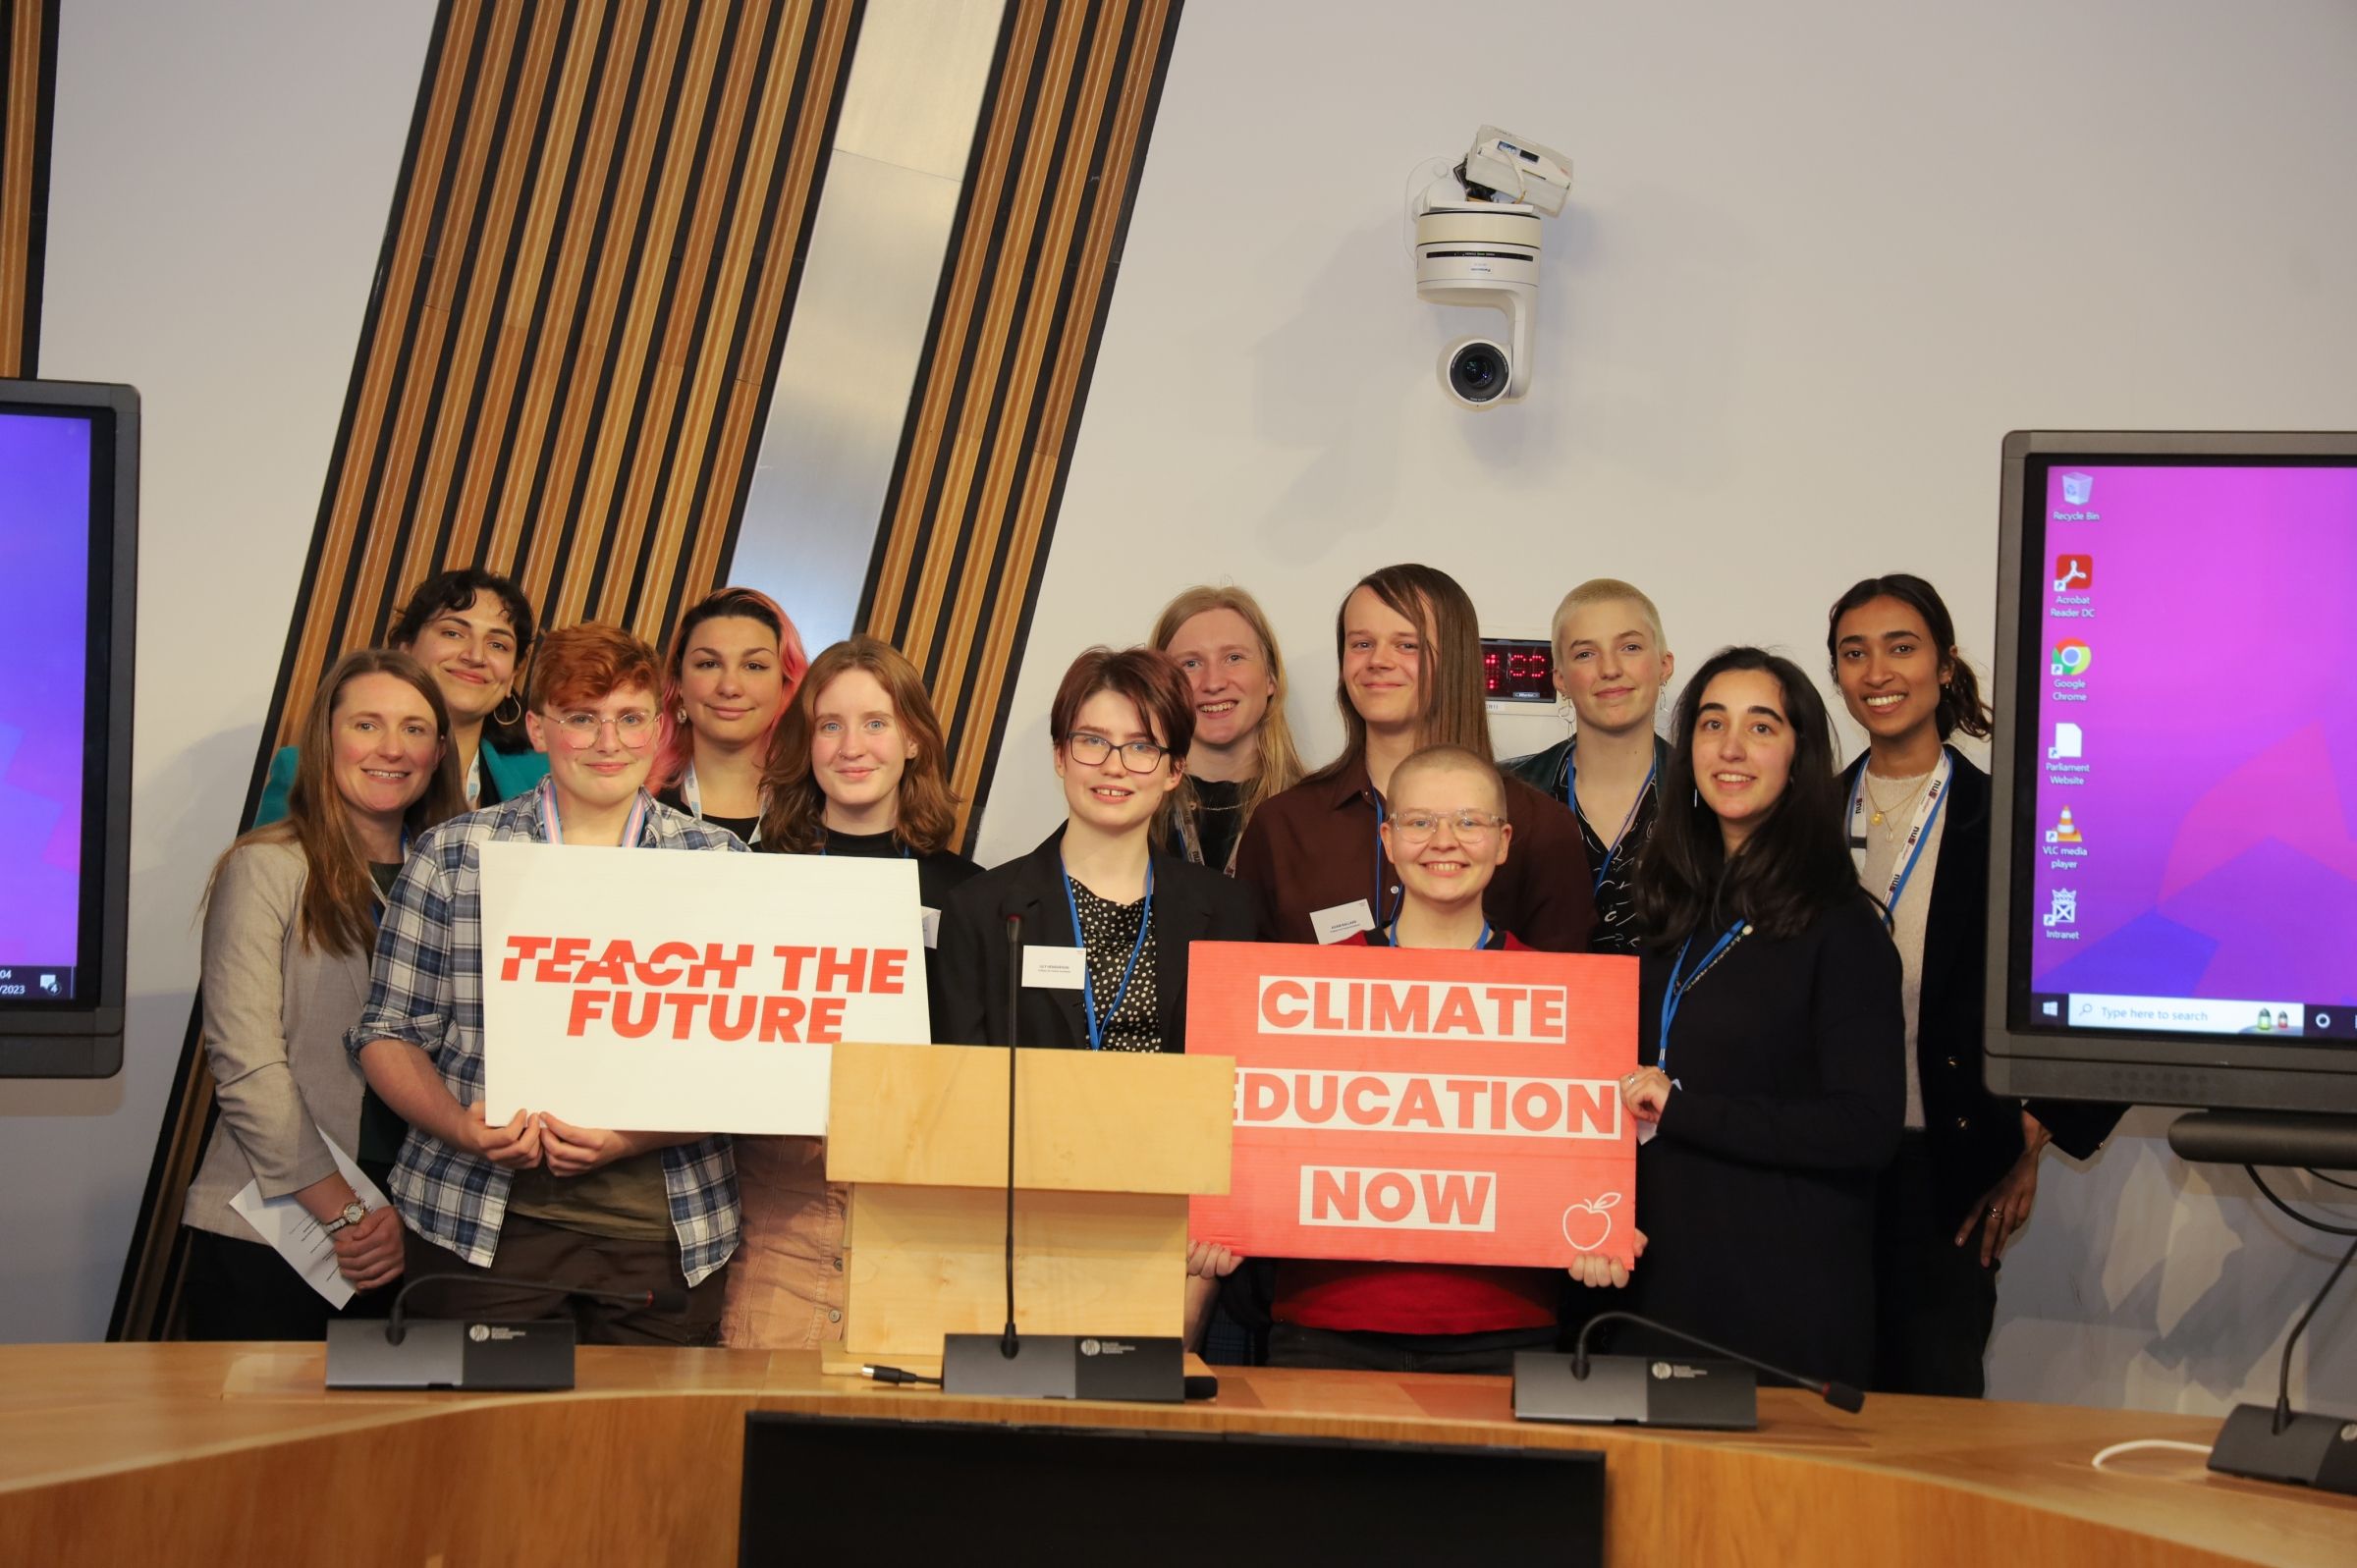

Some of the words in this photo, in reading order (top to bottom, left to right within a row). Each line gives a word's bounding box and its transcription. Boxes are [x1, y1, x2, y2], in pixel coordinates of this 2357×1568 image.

[2053, 511, 2084, 521] Recycle
[2086, 512, 2100, 520] Bin
[2056, 595, 2090, 604] Acrobat
[2051, 608, 2079, 617] Reader
[2081, 608, 2095, 618] DC
[2054, 678, 2086, 689] Google
[2053, 691, 2087, 701] Chrome
[2046, 762, 2090, 772] Parliament
[2051, 776, 2085, 784] Website
[2043, 845, 2058, 855] VLC
[2060, 846, 2088, 856] media
[2051, 858, 2077, 870] player
[2046, 929, 2080, 940] Intranet
[500, 935, 754, 989] TEACH
[773, 946, 908, 995] THE
[1261, 980, 1564, 1038] CLIMATE
[2102, 1006, 2127, 1020] Type
[2130, 1007, 2154, 1019] here
[2158, 1010, 2169, 1019] to
[2172, 1011, 2209, 1021] search
[567, 990, 847, 1044] FUTURE
[1233, 1072, 1616, 1135] DUCATION
[1312, 1169, 1492, 1226] NOW
